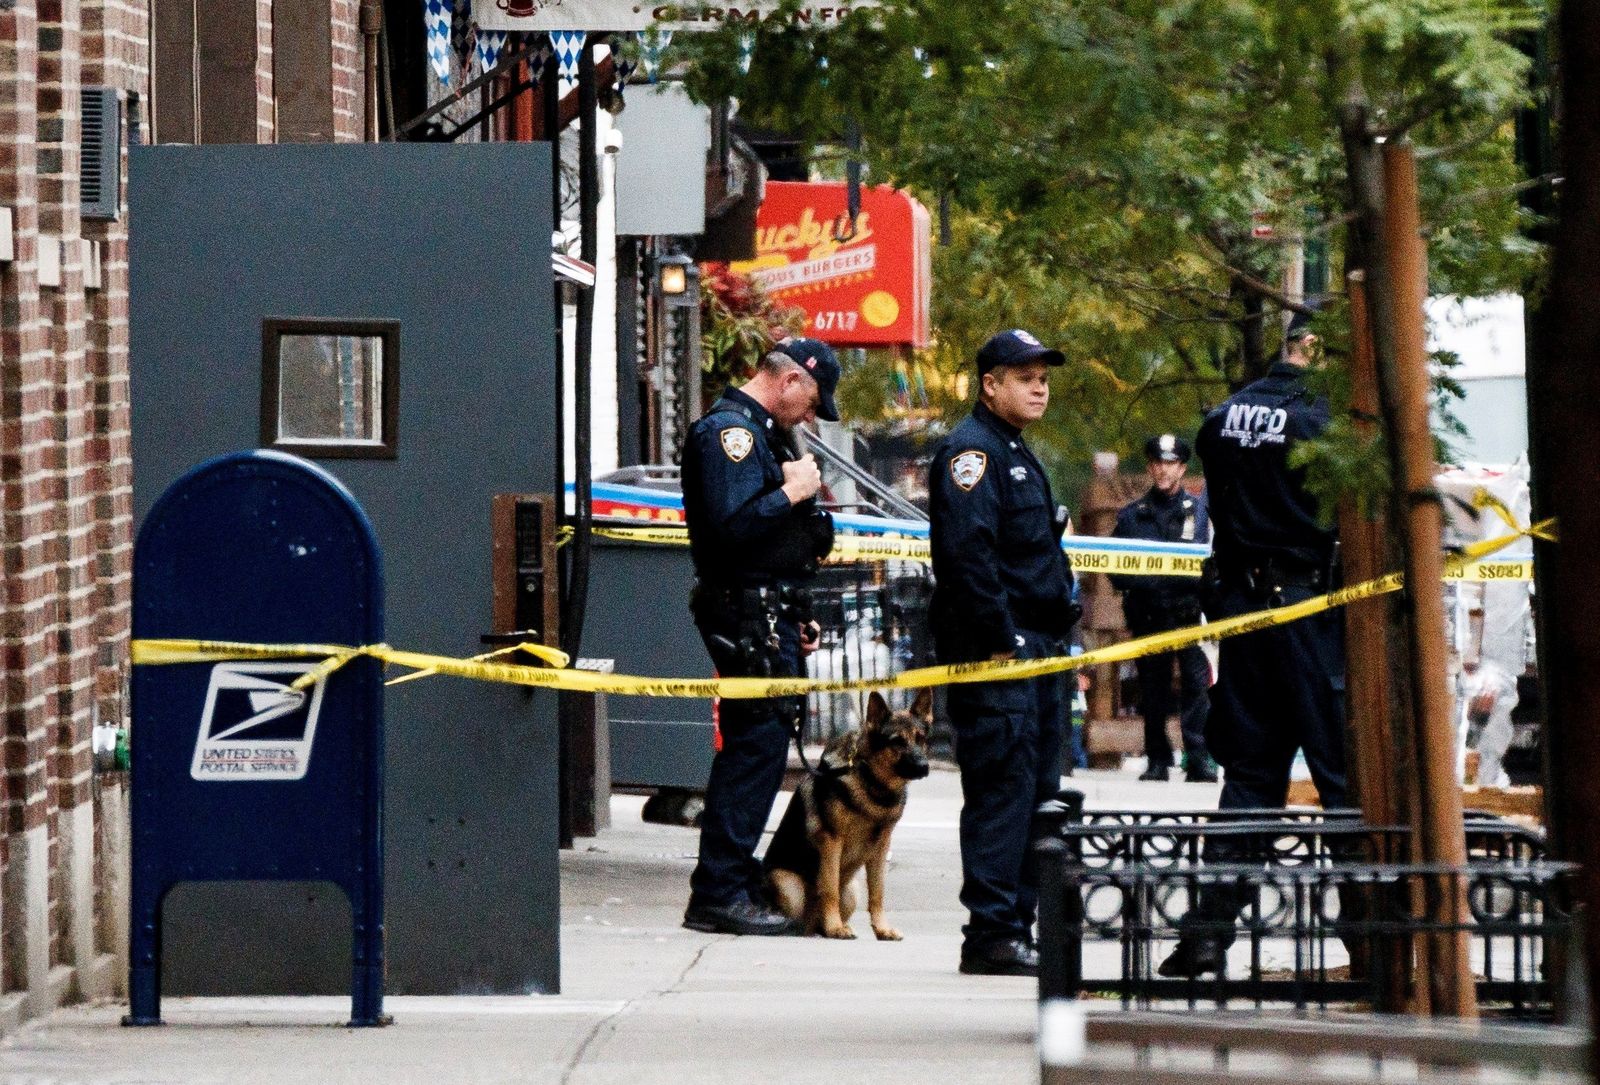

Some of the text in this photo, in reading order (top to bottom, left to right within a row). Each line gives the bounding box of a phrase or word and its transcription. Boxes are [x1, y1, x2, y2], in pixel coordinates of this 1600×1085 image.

[802, 251, 873, 277] BURGERS
[1224, 403, 1288, 434] NYPD
[1115, 555, 1142, 571] NOT
[1145, 556, 1163, 571] DO
[1478, 564, 1524, 579] CROSS
[202, 748, 252, 760] UNITED
[199, 761, 246, 774] POSTAL
